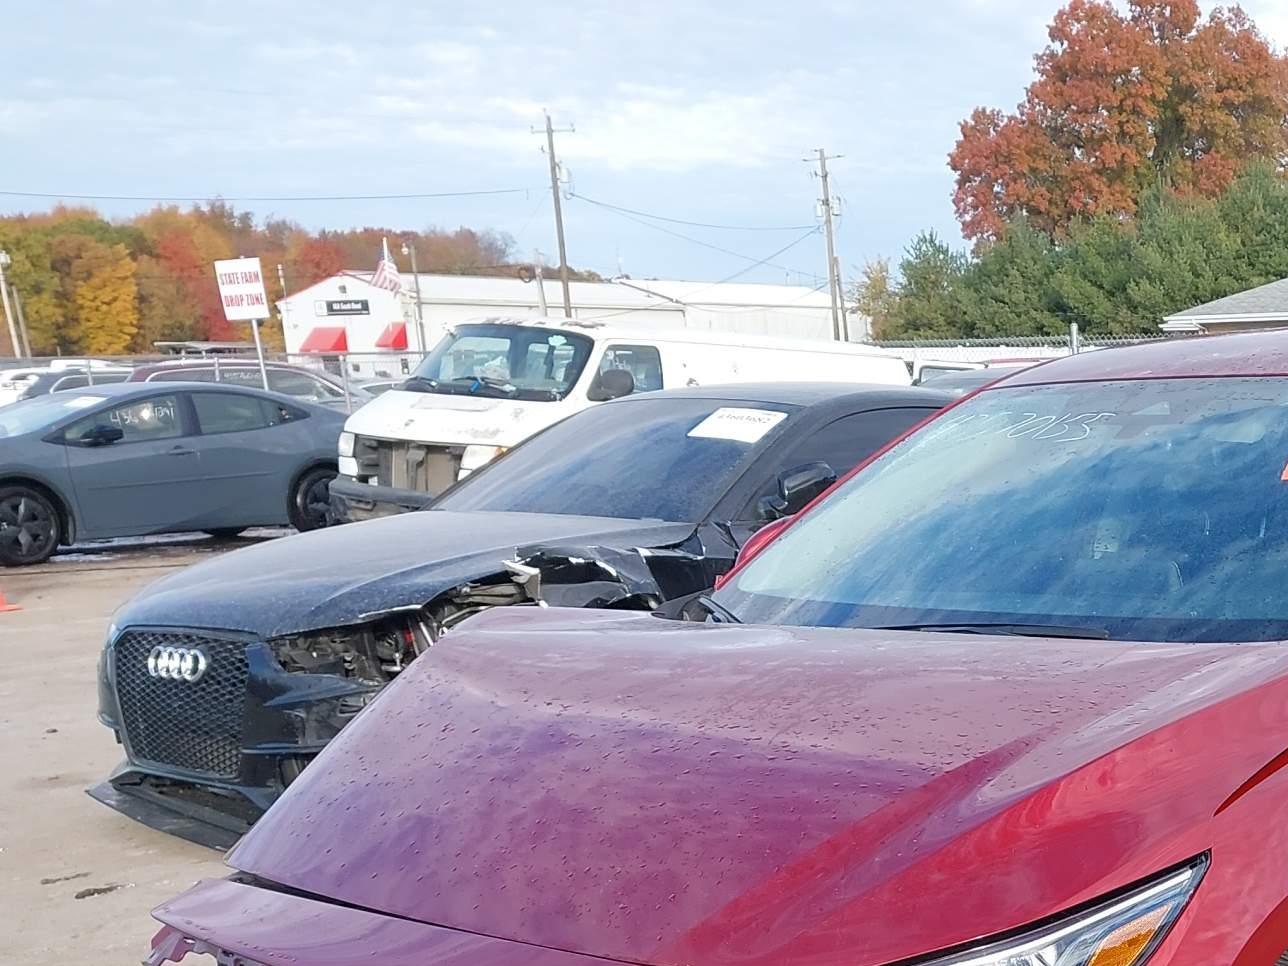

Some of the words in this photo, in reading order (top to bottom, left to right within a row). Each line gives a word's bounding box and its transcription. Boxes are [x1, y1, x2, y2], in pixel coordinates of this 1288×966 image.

[219, 272, 241, 286] STATE
[240, 270, 261, 284] FARM
[224, 294, 244, 307] DROP
[244, 292, 265, 306] ZONE
